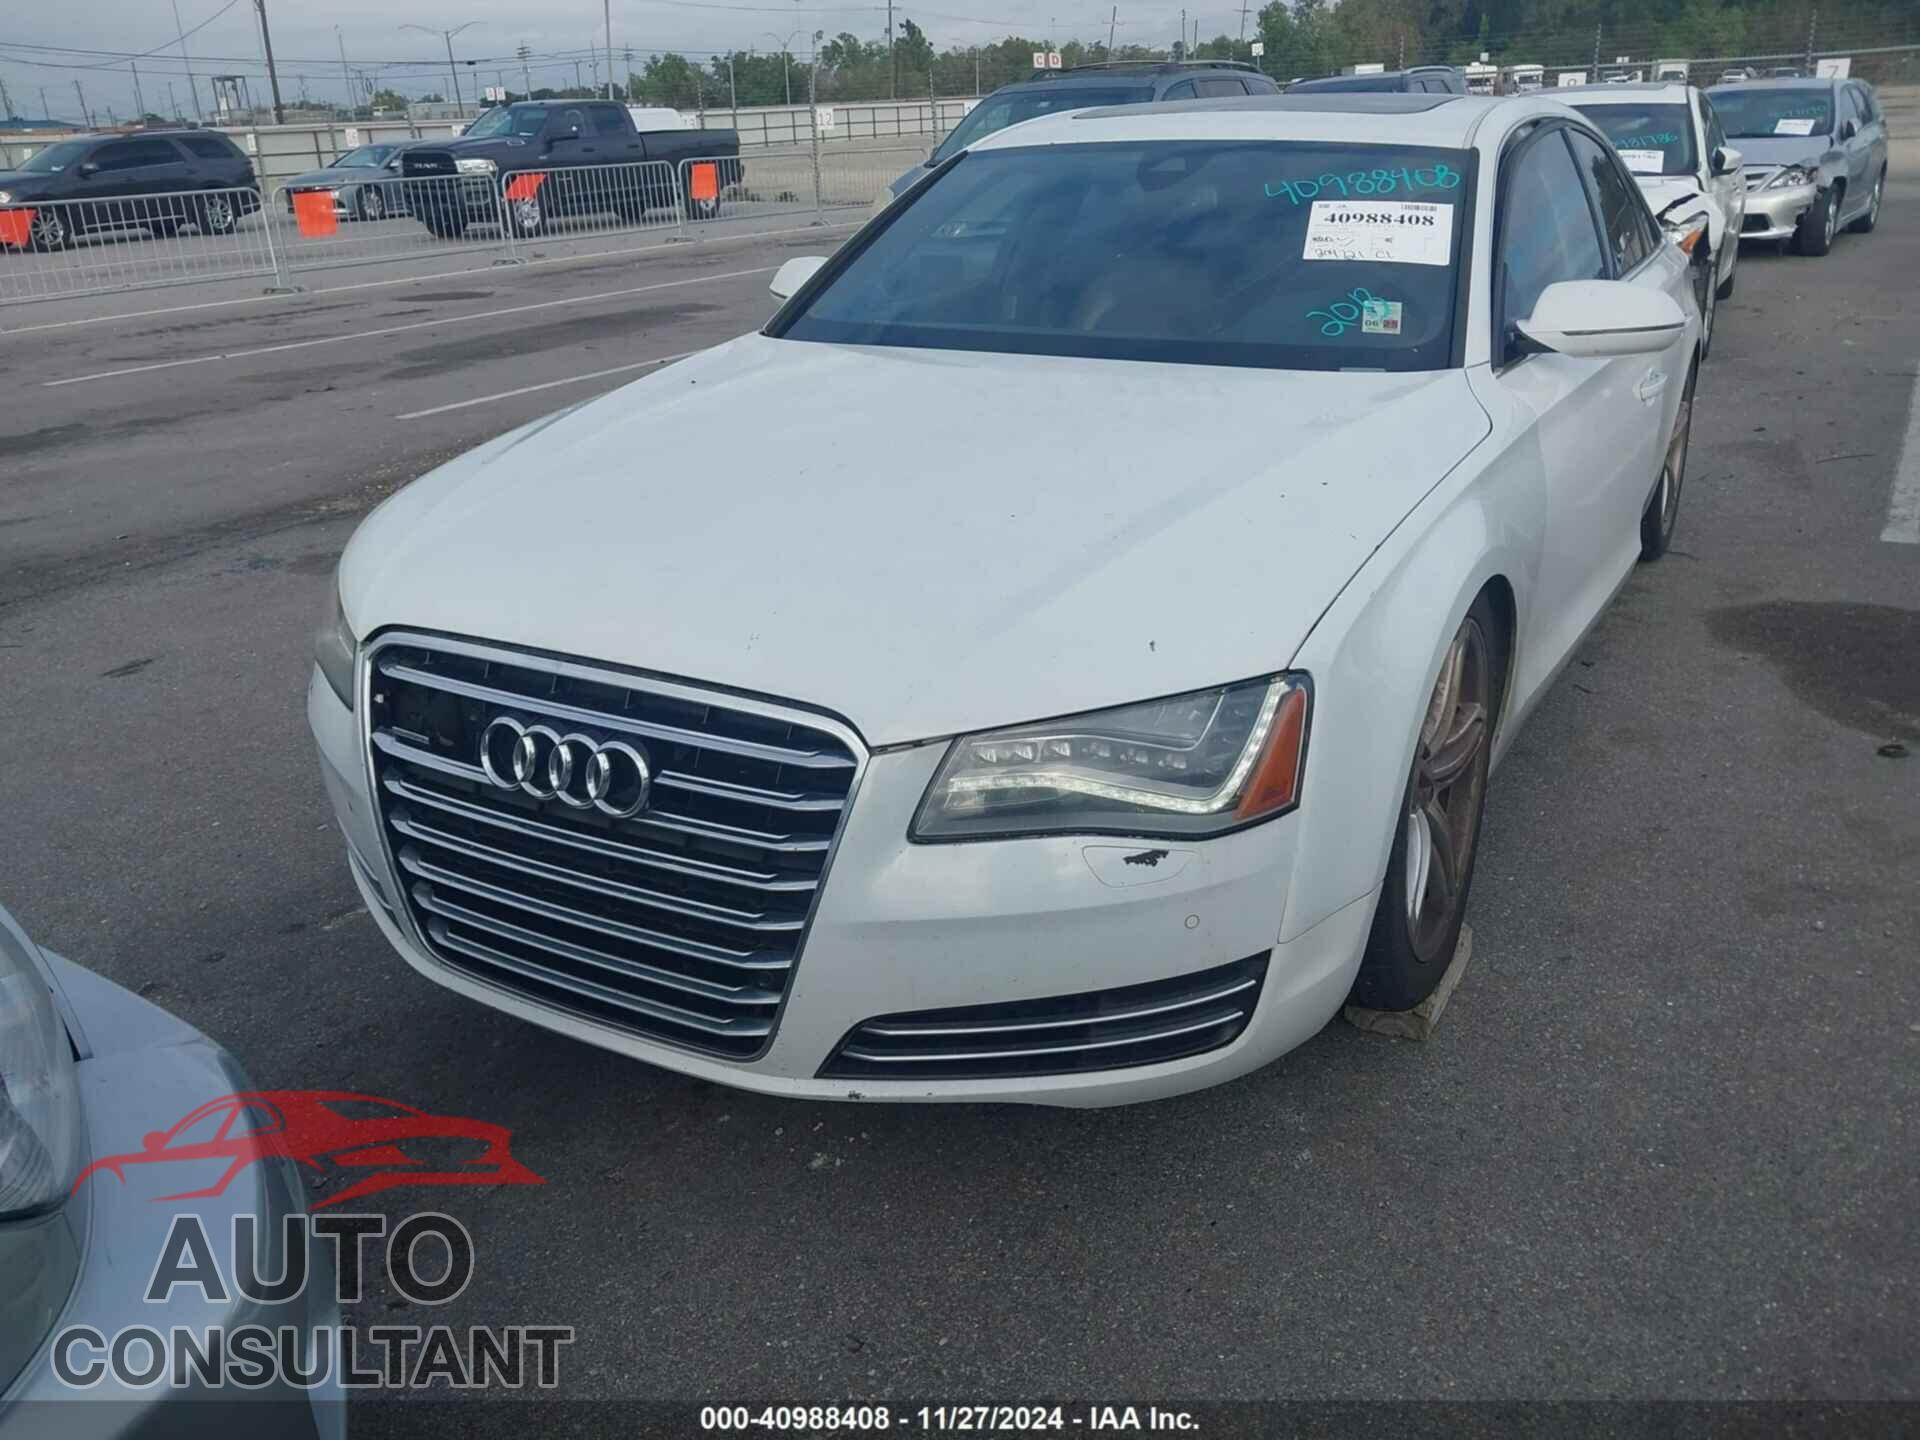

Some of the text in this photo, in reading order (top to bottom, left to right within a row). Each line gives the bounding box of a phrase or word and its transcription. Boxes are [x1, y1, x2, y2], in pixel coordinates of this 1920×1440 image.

[817, 112, 833, 126] 12
[1264, 165, 1461, 205] 40988408
[1323, 212, 1436, 226] 40988408
